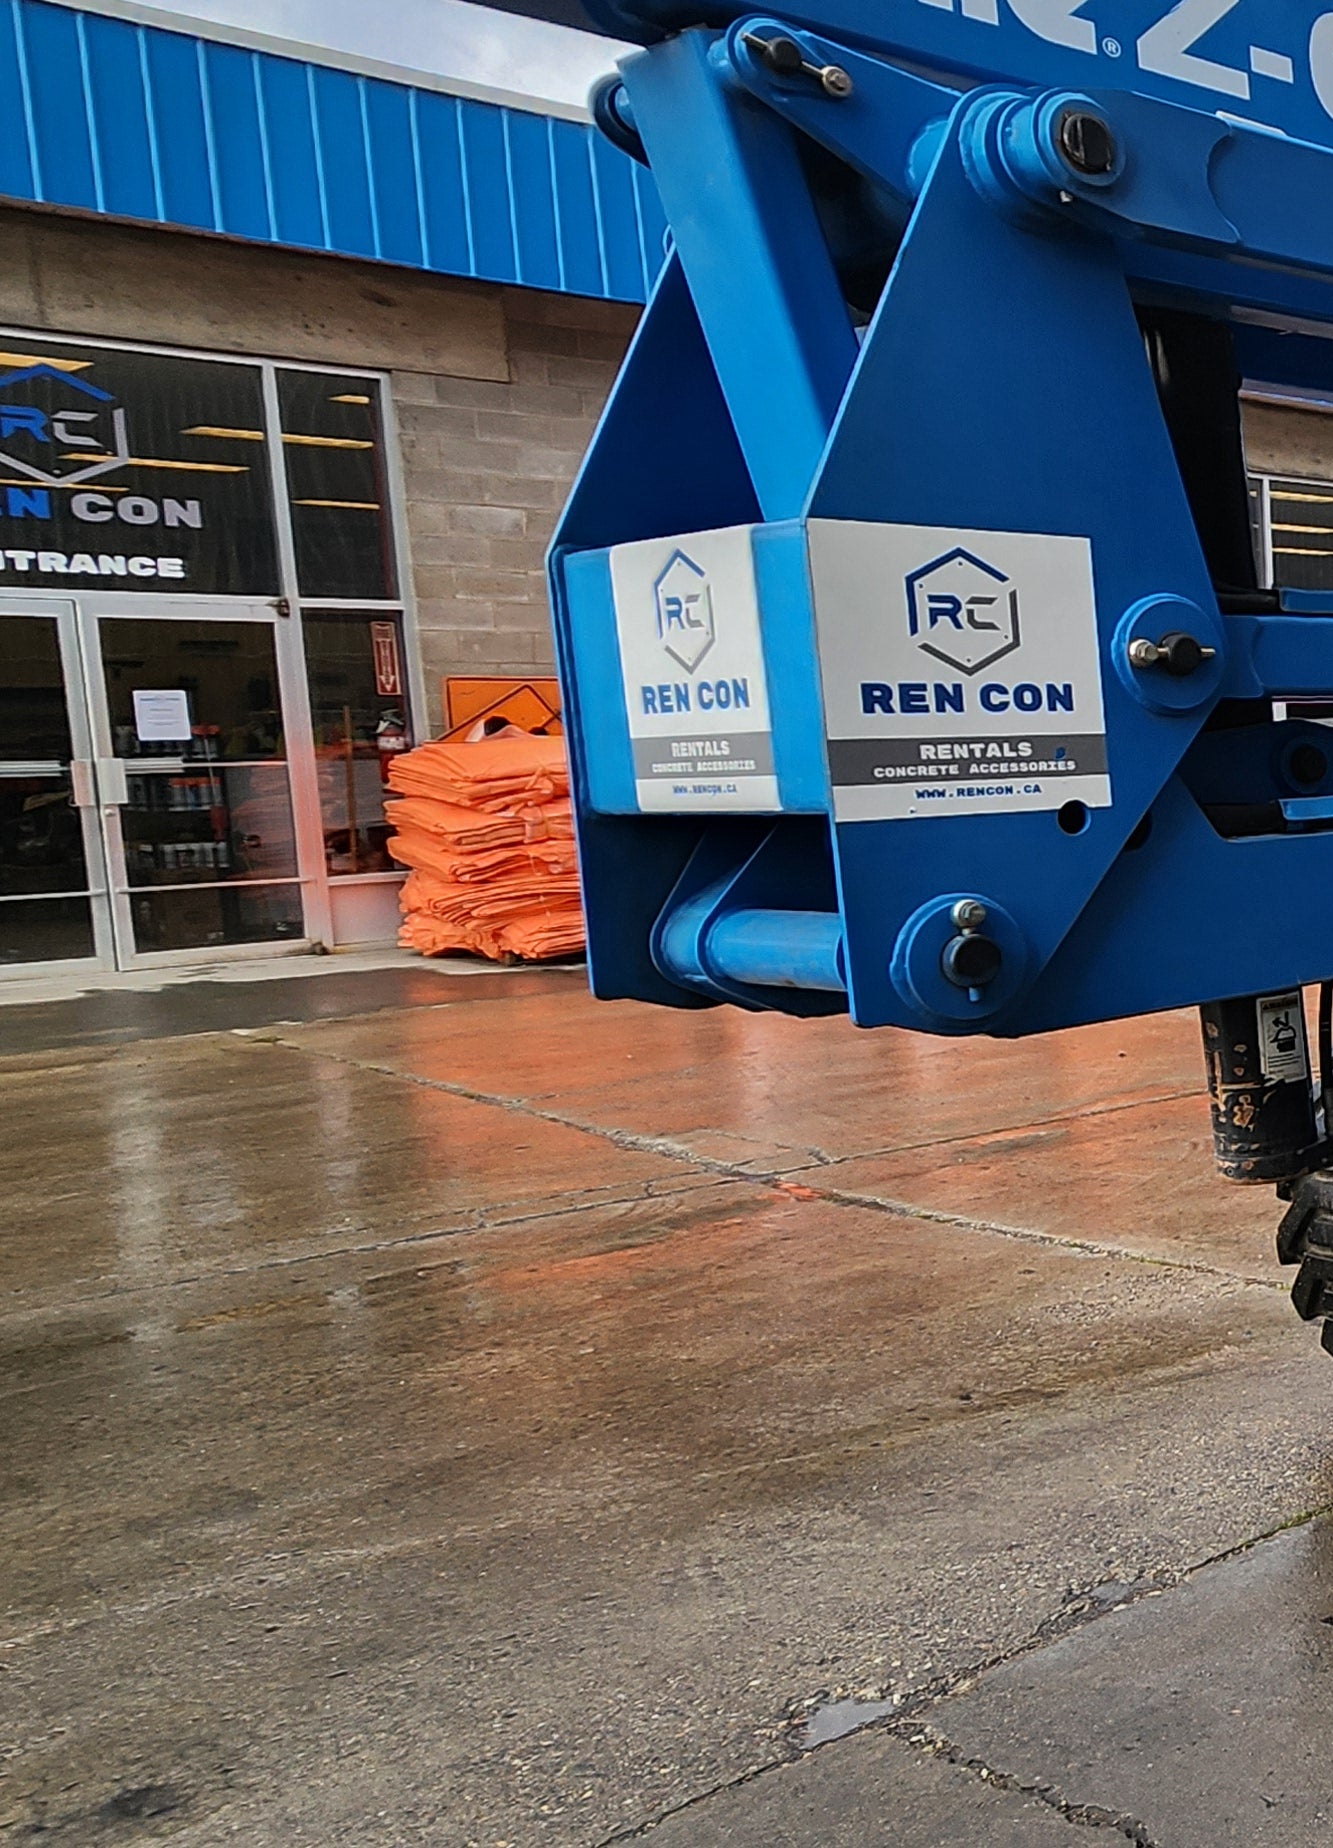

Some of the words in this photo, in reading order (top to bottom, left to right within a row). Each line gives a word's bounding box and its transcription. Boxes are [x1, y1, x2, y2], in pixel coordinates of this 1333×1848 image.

[0, 487, 50, 519] N
[71, 492, 202, 529] CON
[0, 550, 185, 579] TRANCE
[665, 593, 705, 630] RC
[927, 593, 1001, 631] RC
[641, 682, 691, 714] REN
[697, 678, 750, 710] CON
[860, 682, 965, 714] REN
[979, 683, 1074, 713] CON
[671, 740, 730, 758] RENTALS
[919, 742, 1033, 761] RENTALS
[652, 762, 693, 773] CONCRETE
[697, 760, 756, 772] ACCESSORIES
[873, 763, 960, 778] CONCRETE
[969, 760, 1077, 774] ACCESSORIES
